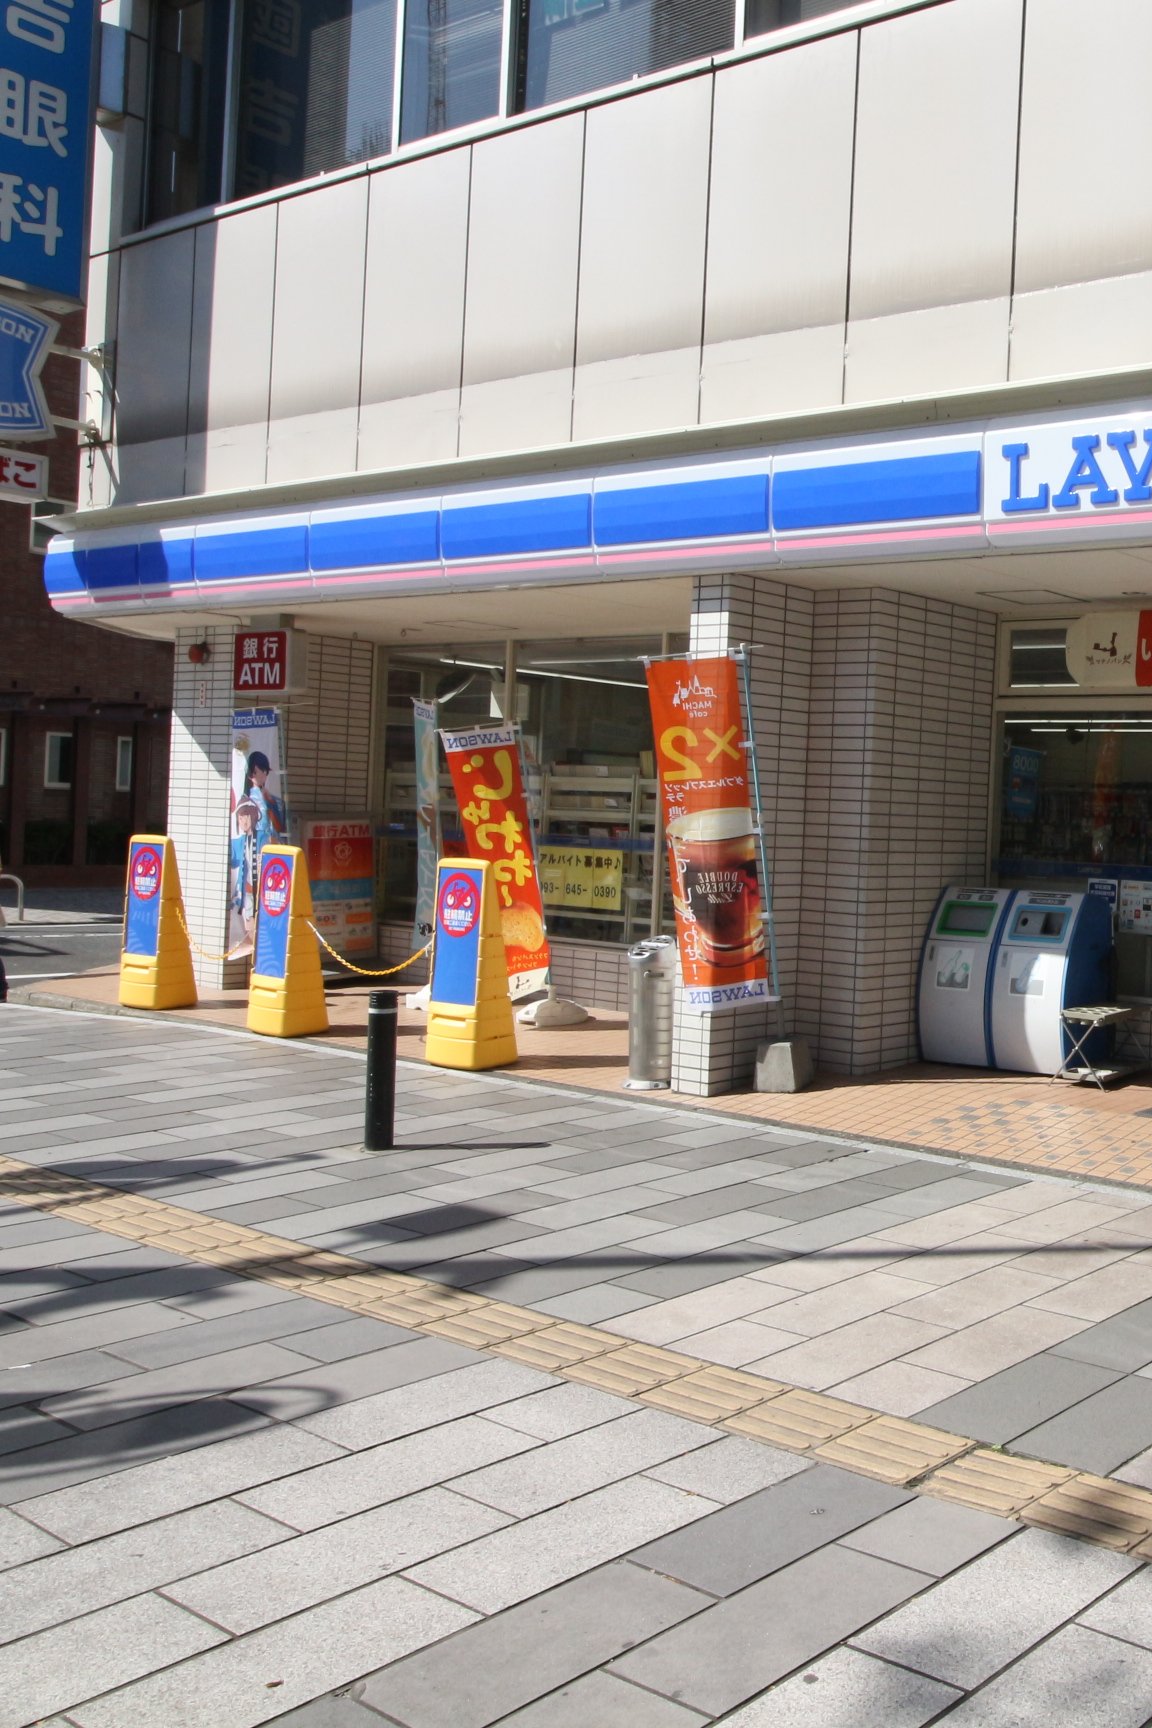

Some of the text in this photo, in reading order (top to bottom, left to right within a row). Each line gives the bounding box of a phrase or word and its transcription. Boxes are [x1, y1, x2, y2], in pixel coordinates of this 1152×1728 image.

[242, 636, 279, 659] 銀行
[239, 662, 280, 685] ATM
[594, 886, 616, 898] 0390
